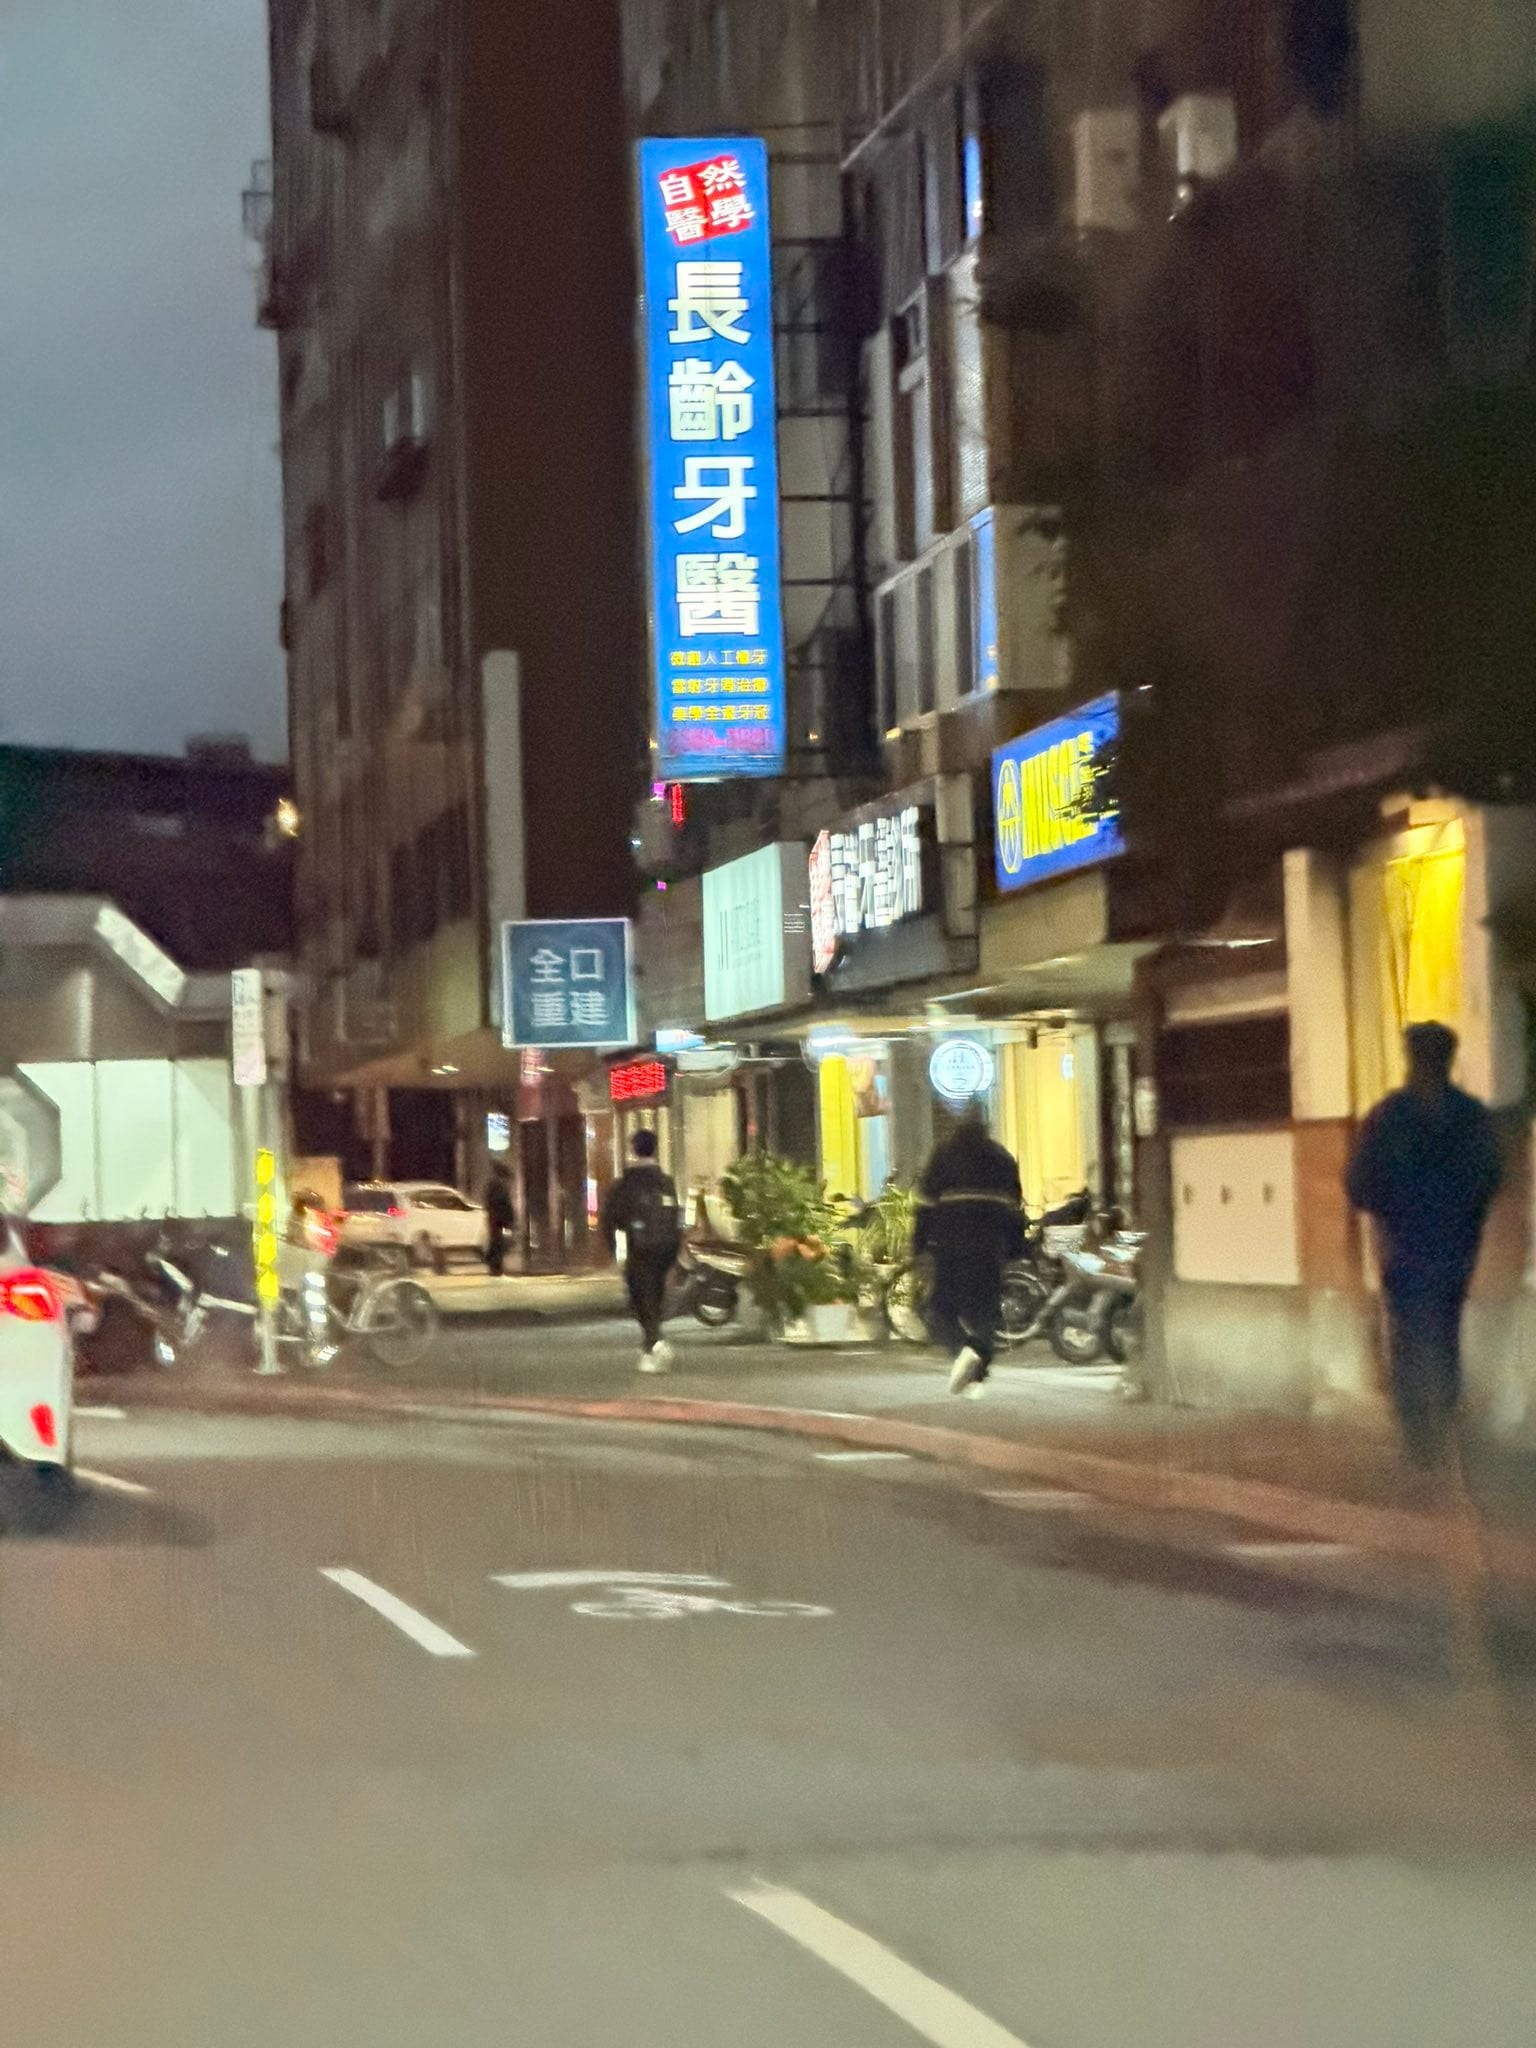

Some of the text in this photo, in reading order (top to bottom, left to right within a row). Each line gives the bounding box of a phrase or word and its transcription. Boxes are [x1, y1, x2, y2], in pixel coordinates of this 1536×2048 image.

[659, 159, 747, 205] 自然
[664, 193, 757, 242] 醫學
[667, 260, 761, 638] 長齡牙醫
[529, 947, 605, 983] 全口
[530, 989, 609, 1027] 重建
